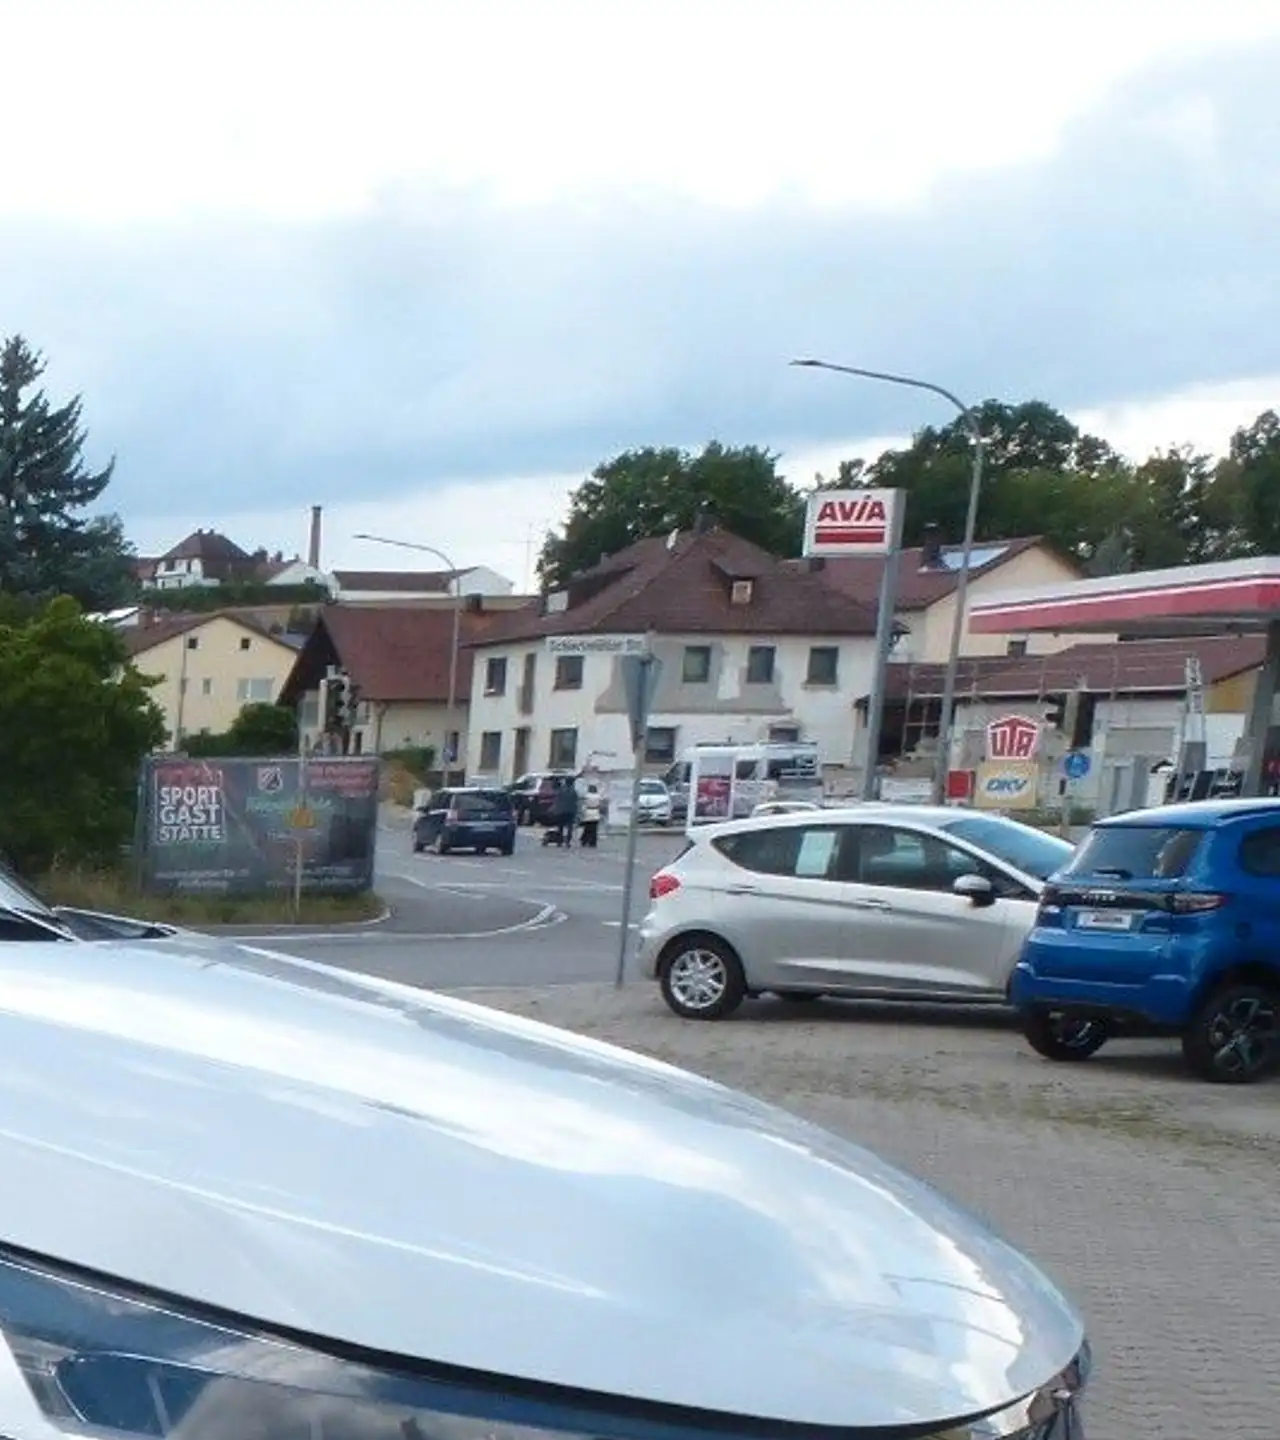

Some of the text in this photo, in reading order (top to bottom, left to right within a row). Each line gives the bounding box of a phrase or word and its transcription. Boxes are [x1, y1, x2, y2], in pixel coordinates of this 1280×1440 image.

[817, 494, 886, 522] AVIA
[990, 717, 1037, 757] UTA
[160, 787, 219, 805] SPORT
[161, 804, 220, 825] GAST
